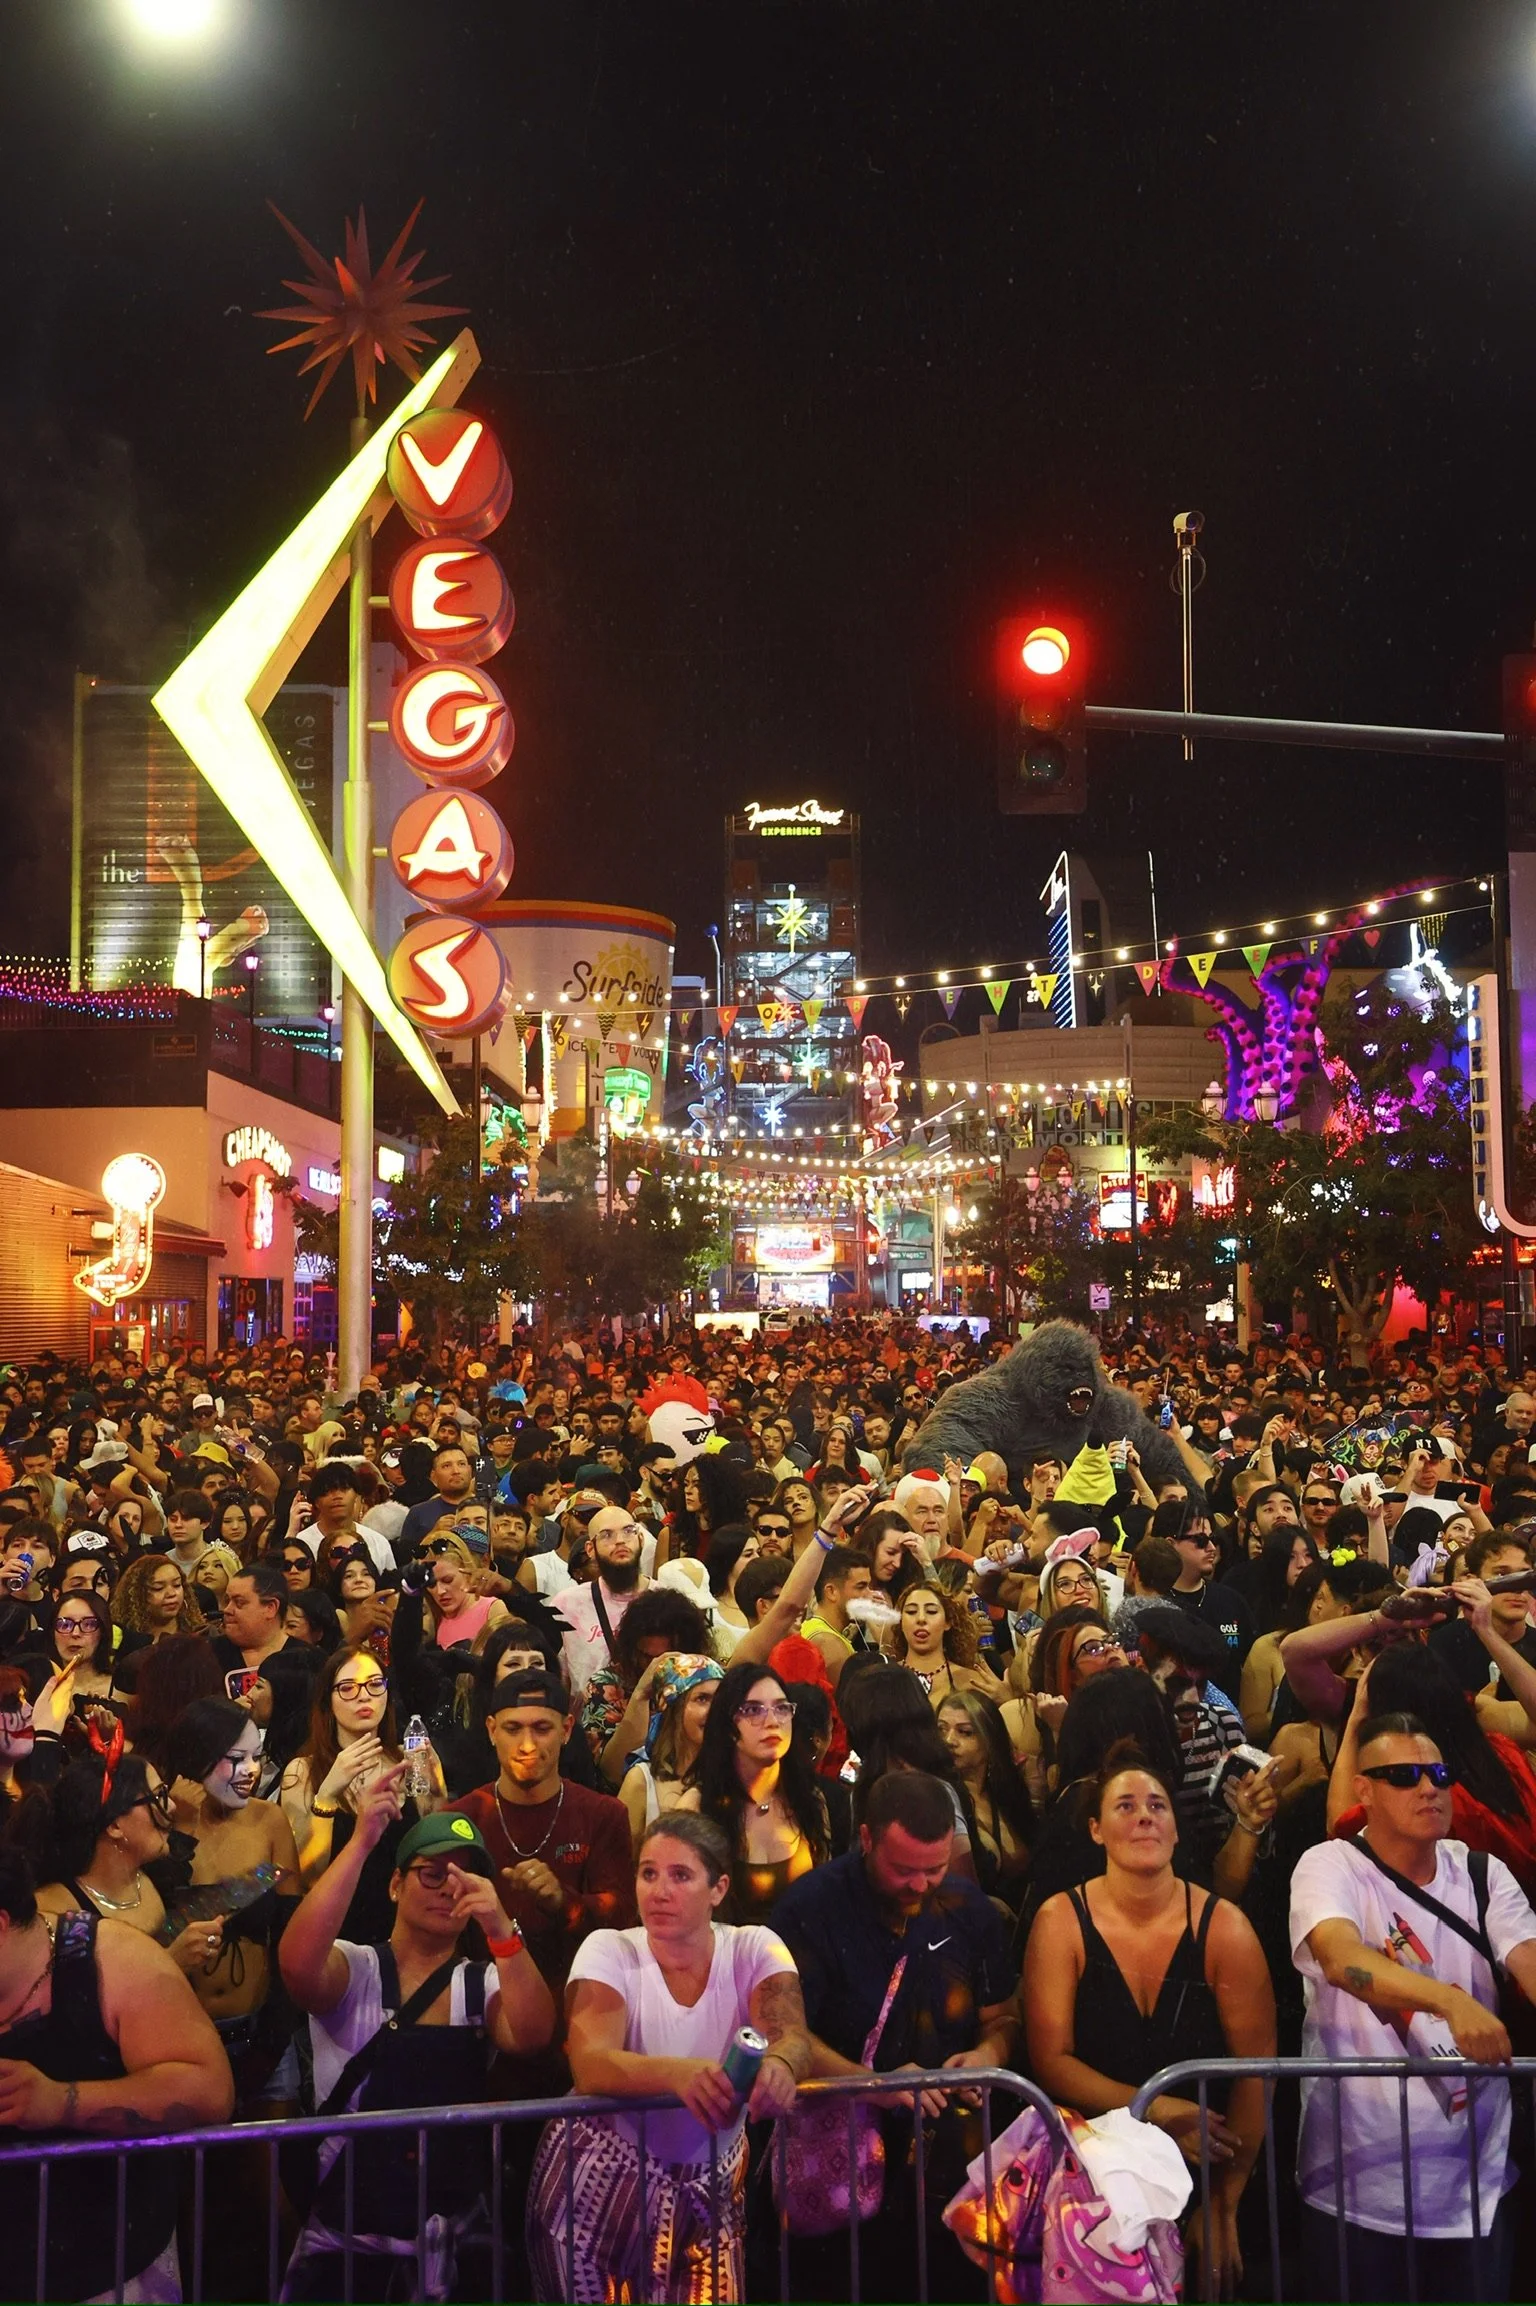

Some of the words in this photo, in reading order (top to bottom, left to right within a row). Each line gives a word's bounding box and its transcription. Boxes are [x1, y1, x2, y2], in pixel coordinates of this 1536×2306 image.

[398, 421, 506, 1019] VEGAS
[761, 826, 822, 836] EXPERIENCE
[562, 960, 665, 1008] Surfside
[567, 1041, 588, 1053] ICE
[226, 1126, 292, 1178] CHEAPSHOT
[1102, 1177, 1145, 1190] PIZZEIA
[1415, 1438, 1432, 1449] NY
[1219, 1623, 1239, 1634] GOLF
